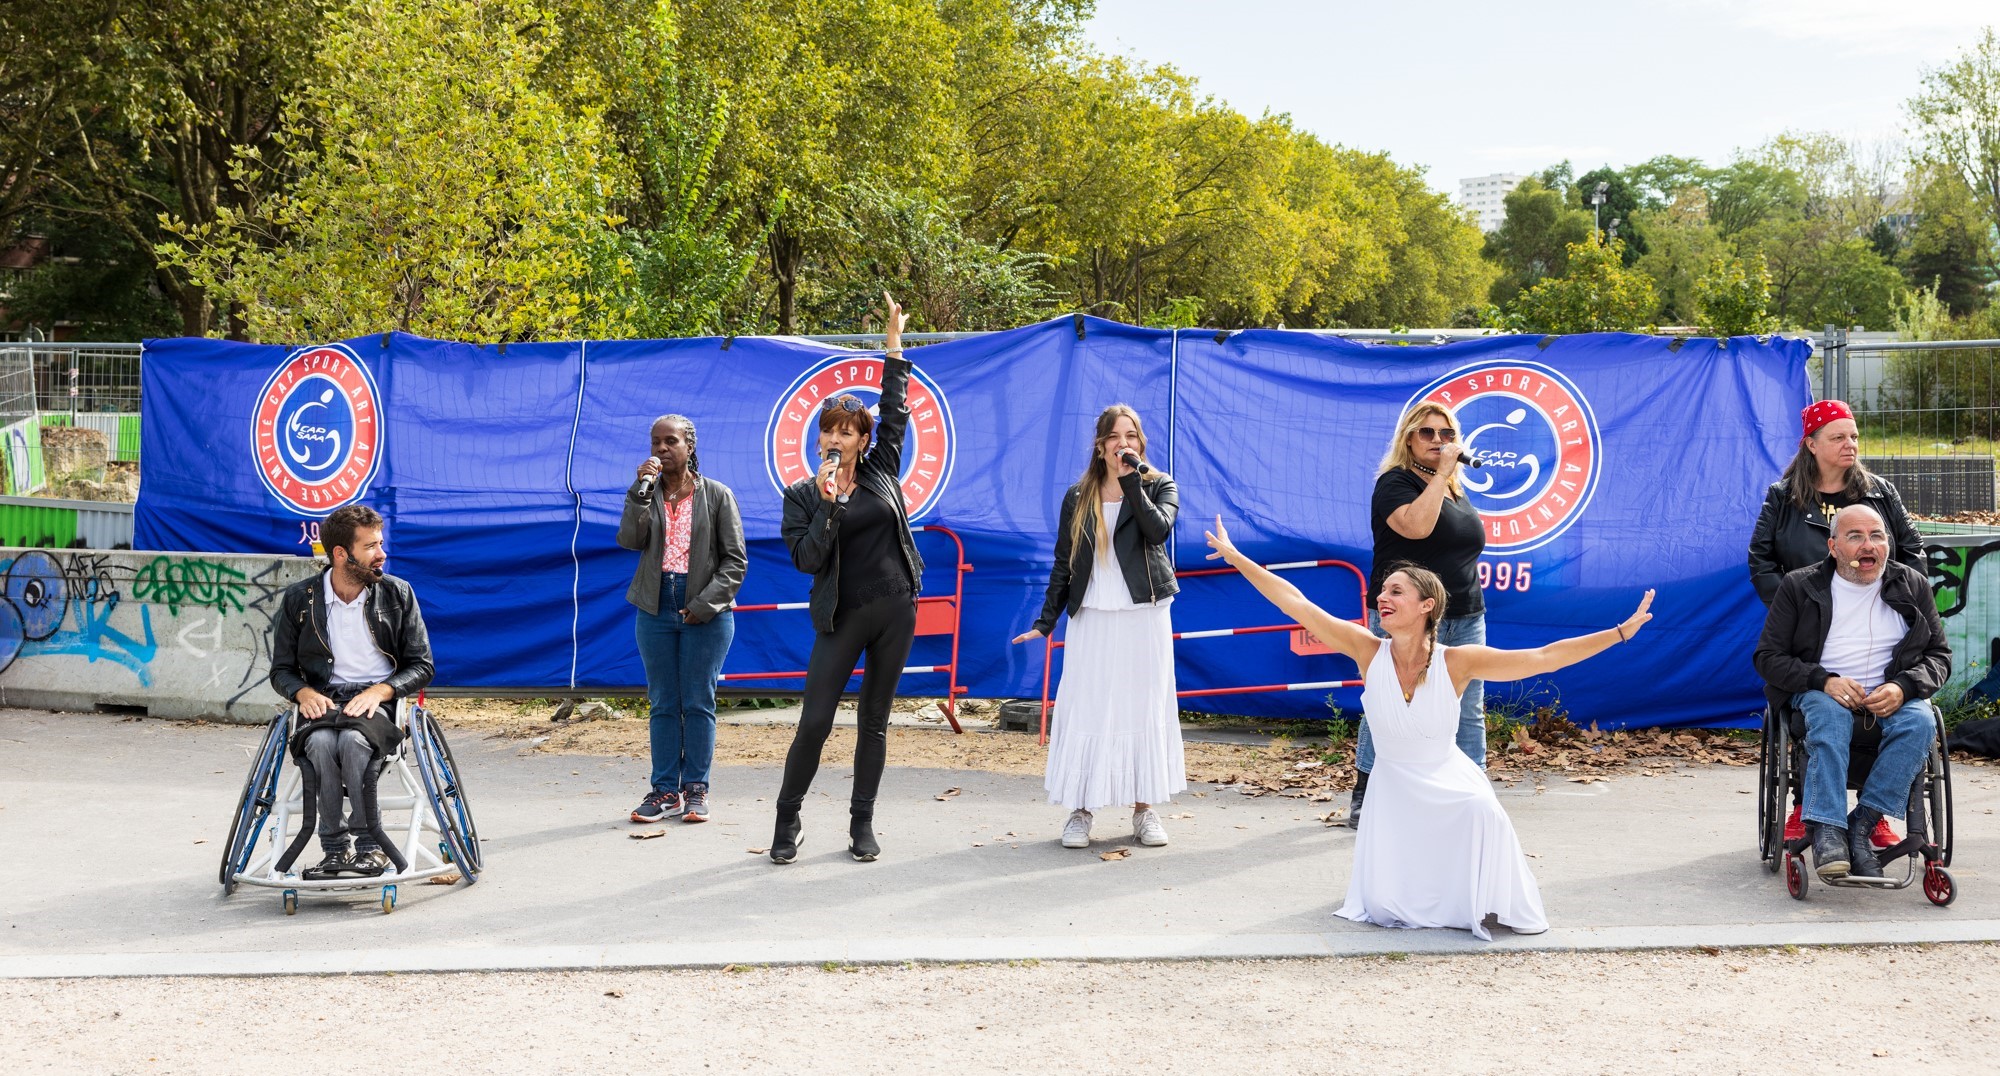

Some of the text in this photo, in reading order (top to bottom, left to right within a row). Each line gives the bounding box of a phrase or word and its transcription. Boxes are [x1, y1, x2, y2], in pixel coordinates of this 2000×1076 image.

[834, 366, 880, 384] SPO
[789, 386, 819, 422] CAP
[912, 397, 937, 434] ART
[262, 356, 371, 503] CAP SPORT ART AVENTURE AMITIÉ
[300, 426, 326, 434] CAP
[1469, 374, 1582, 537] SPORT ART AVENTUR
[1478, 450, 1518, 459] CAP
[904, 453, 937, 506] AVEN
[298, 521, 320, 545] 19
[1476, 562, 1533, 592] 995
